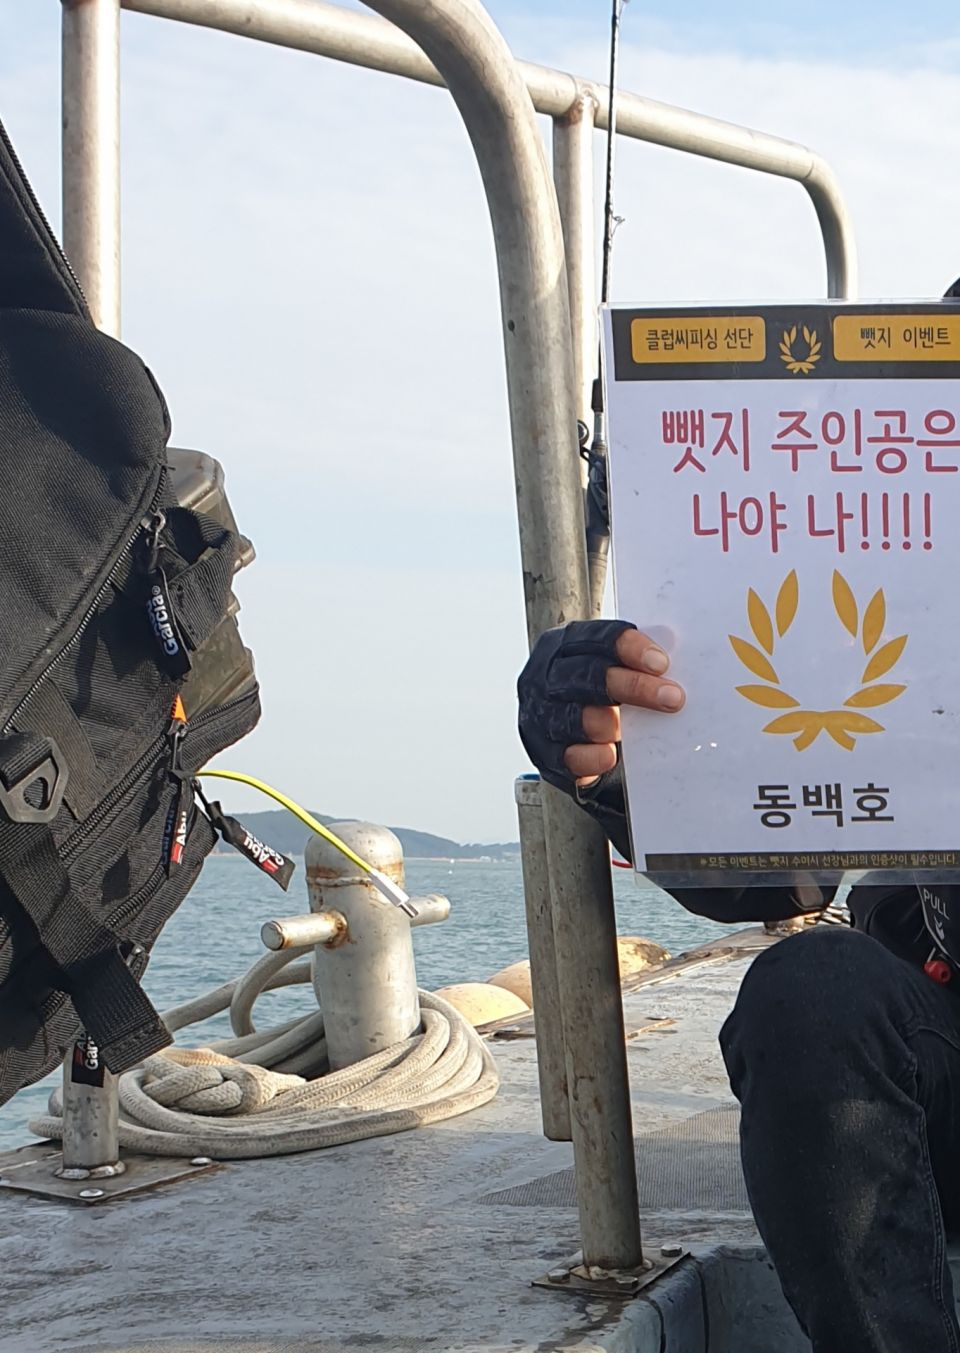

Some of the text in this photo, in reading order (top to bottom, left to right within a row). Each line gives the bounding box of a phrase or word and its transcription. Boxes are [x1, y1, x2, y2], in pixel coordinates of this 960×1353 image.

[645, 326, 754, 353] 클럽씨피싱 선단
[860, 325, 952, 349] 뺏지 이벤트
[661, 408, 750, 474] 뺏지
[692, 491, 934, 554] 나야 나!!!!
[752, 782, 895, 828] 동백호
[243, 835, 270, 863] Abu
[923, 888, 950, 920] PULL
